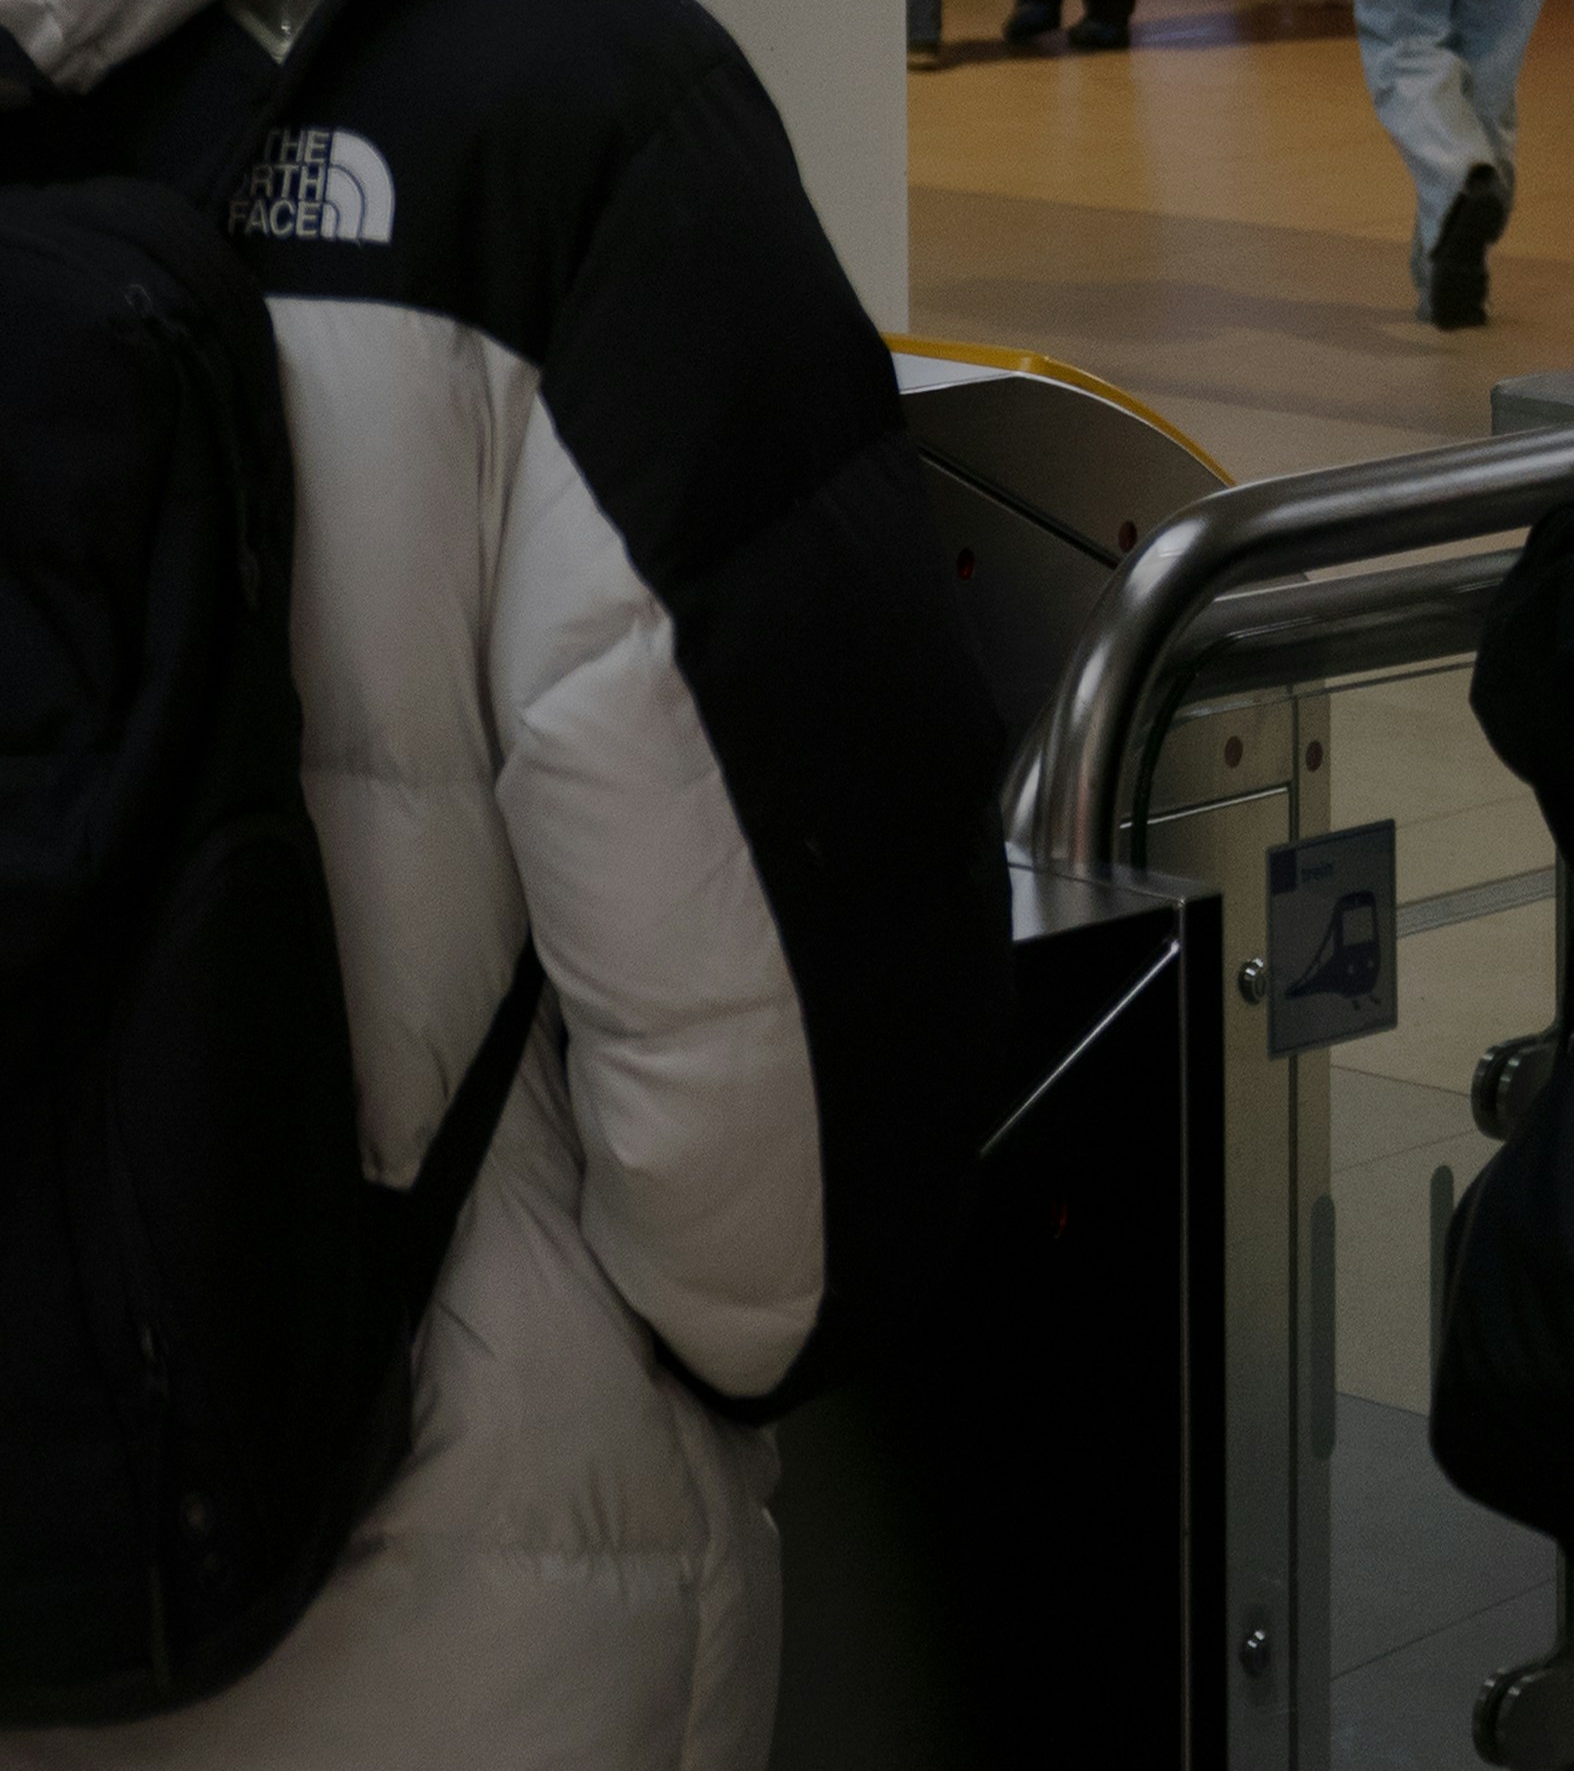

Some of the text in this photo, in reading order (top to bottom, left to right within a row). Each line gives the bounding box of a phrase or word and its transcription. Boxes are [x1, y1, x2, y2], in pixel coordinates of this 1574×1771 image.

[264, 126, 330, 163] THE
[236, 162, 326, 201] RTH
[227, 198, 321, 240] FACE
